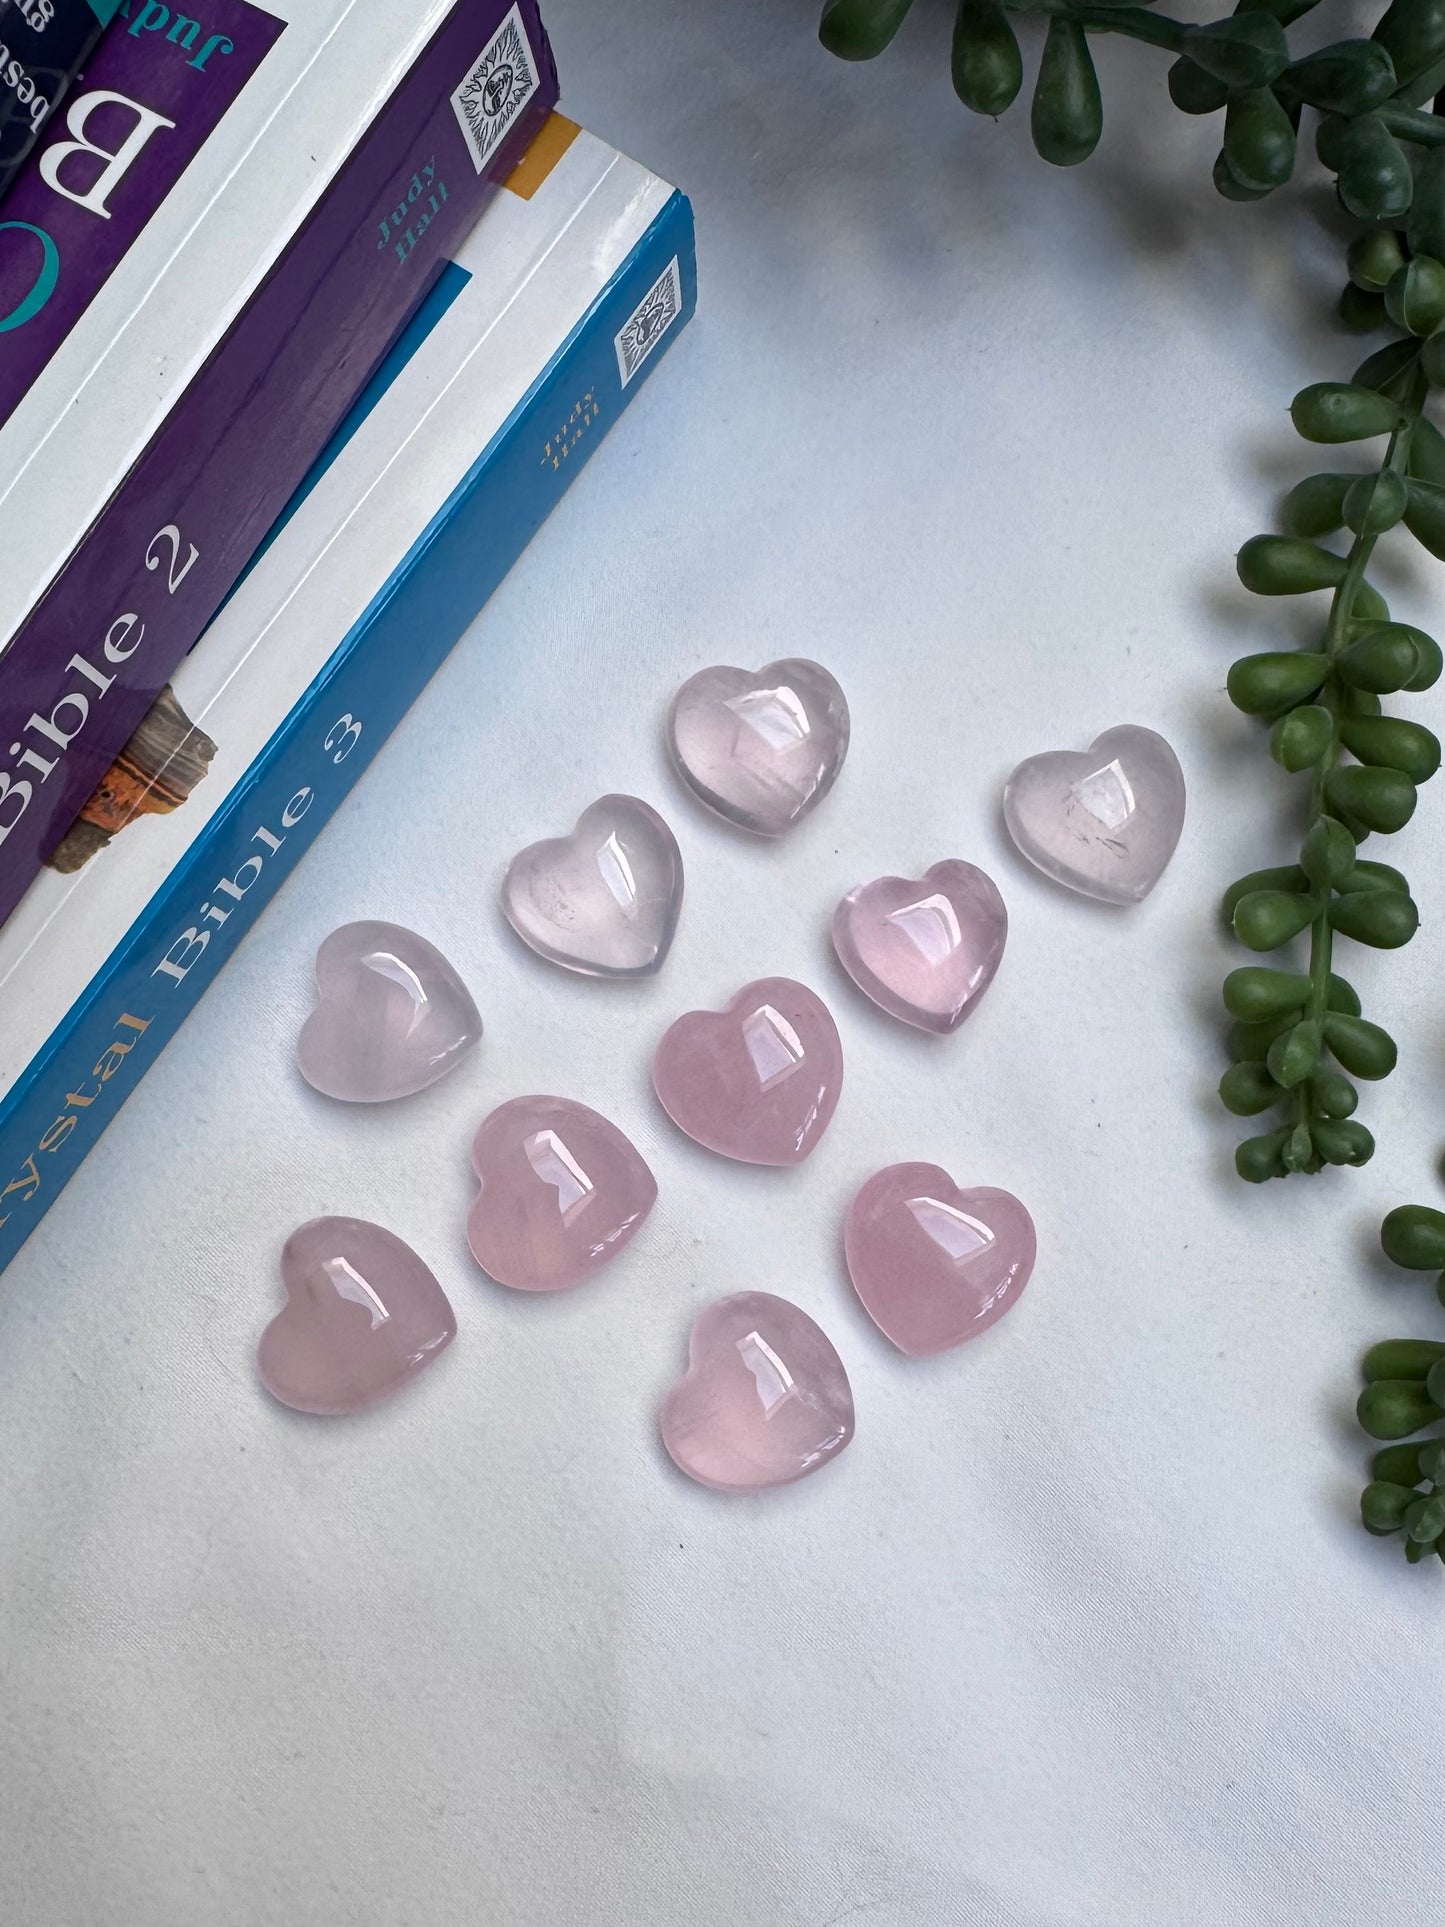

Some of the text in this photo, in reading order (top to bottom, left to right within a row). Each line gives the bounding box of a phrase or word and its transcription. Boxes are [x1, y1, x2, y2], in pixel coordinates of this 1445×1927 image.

[39, 90, 176, 219] B
[378, 154, 435, 250] Judy
[395, 182, 449, 264] Hall
[540, 386, 594, 465] Judy
[553, 402, 599, 471] Hall
[0, 525, 200, 846] Bible 2
[0, 713, 362, 1229] ystal Bible 3
